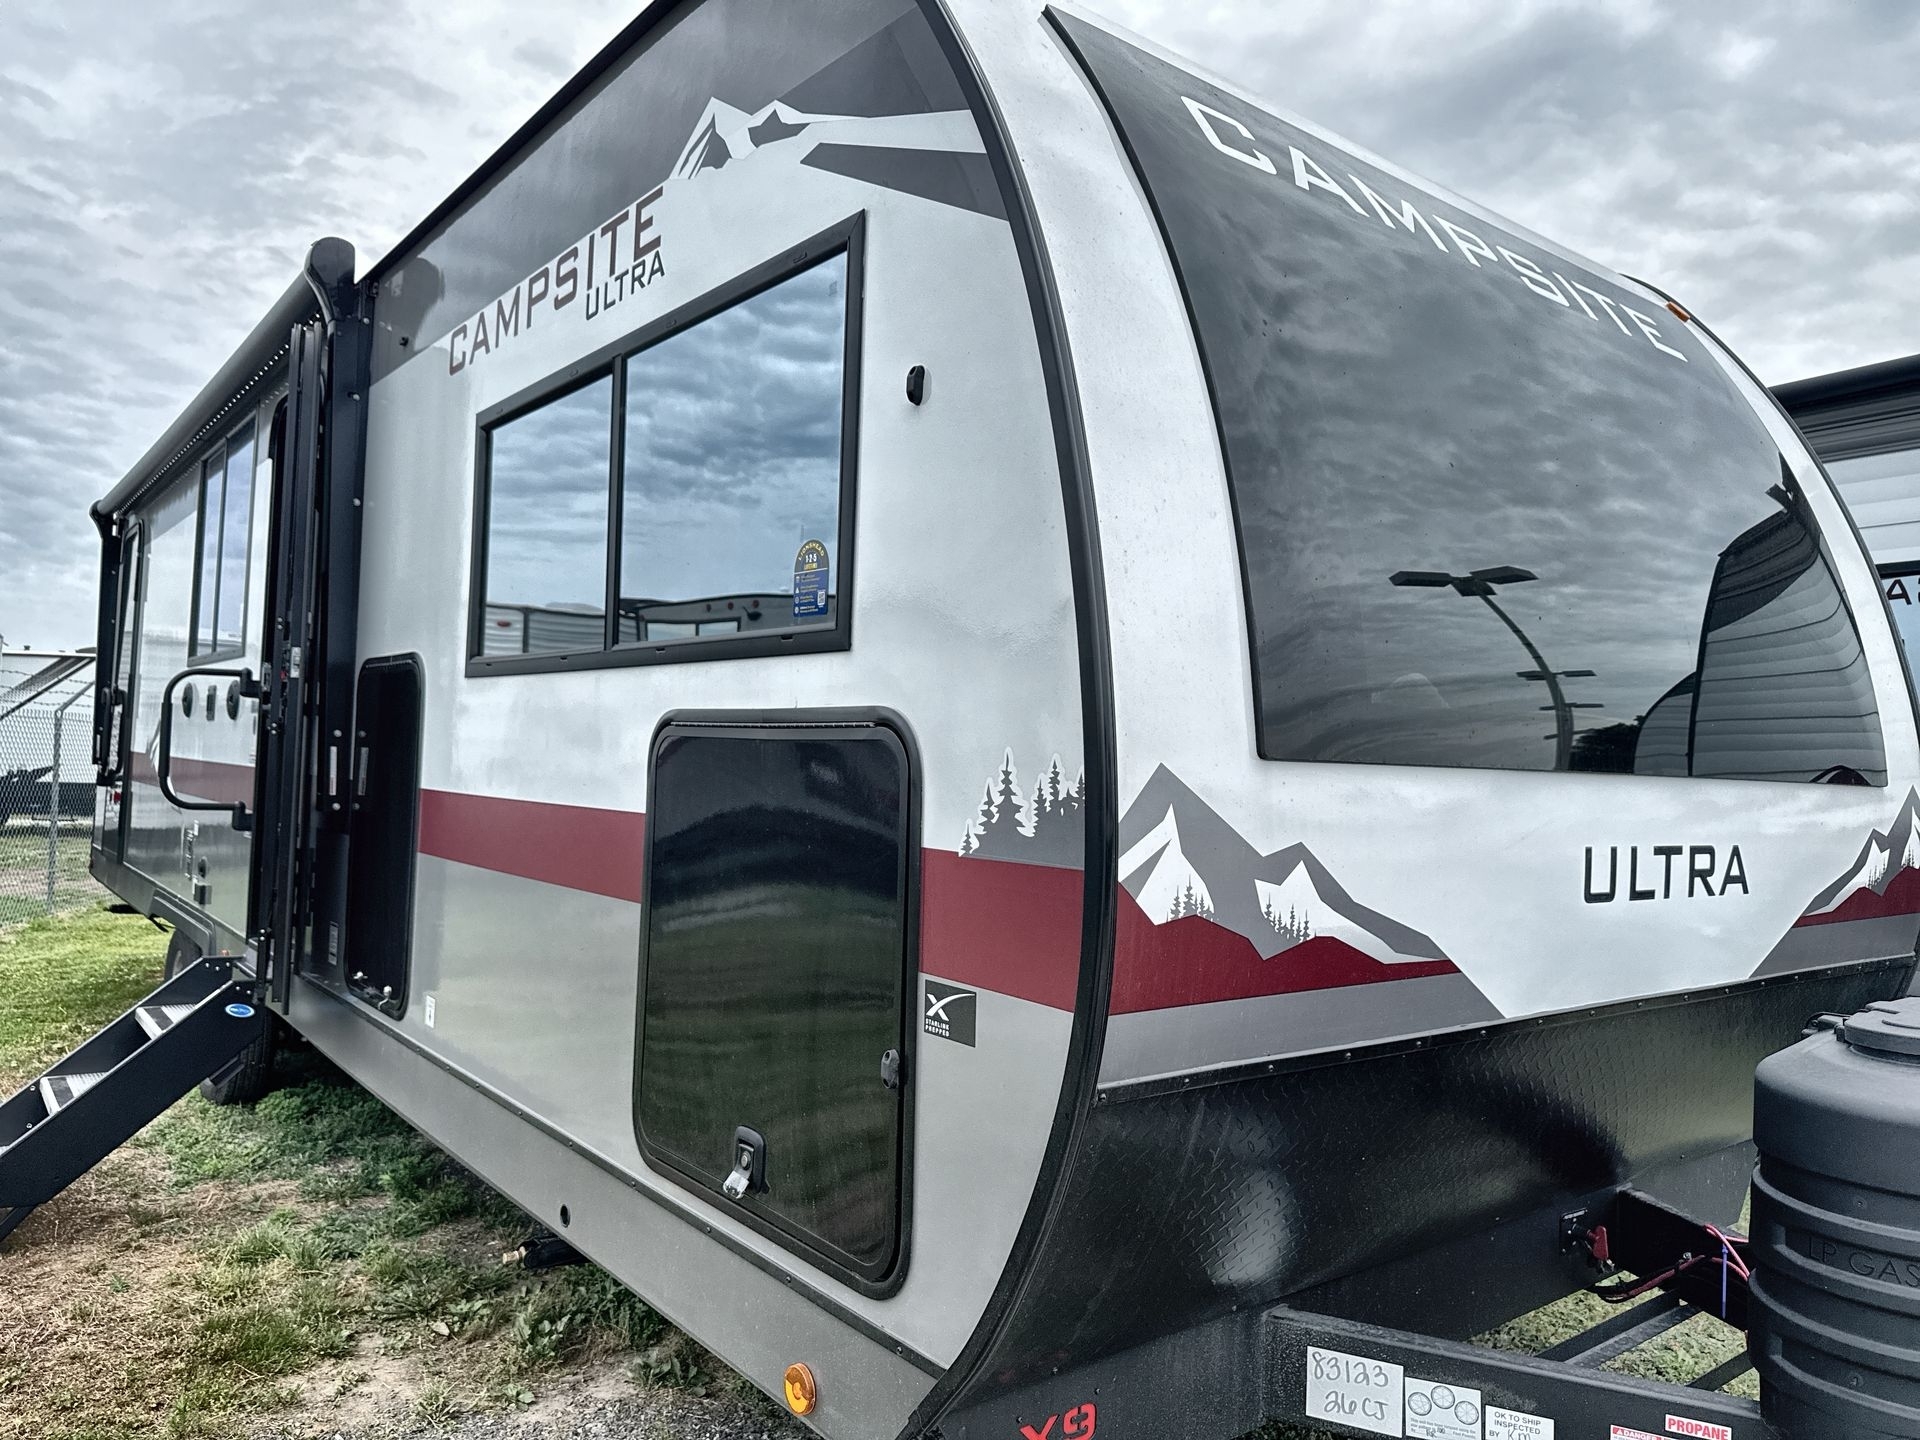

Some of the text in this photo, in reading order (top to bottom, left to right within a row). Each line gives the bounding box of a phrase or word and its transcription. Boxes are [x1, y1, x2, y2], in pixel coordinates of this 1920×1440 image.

[1181, 96, 1688, 362] CAMPSITE
[449, 186, 664, 376] CAMPSITE
[585, 250, 665, 321] ULTRA
[1584, 844, 1749, 904] ULTRA
[925, 1018, 950, 1031] STARLINK
[1809, 1236, 1920, 1287] LP GAS
[1312, 1351, 1389, 1387] 83123
[1494, 1411, 1541, 1426] OK TO SHIP
[1494, 1420, 1541, 1435] INSPECTED
[1667, 1418, 1729, 1440] PROPANE
